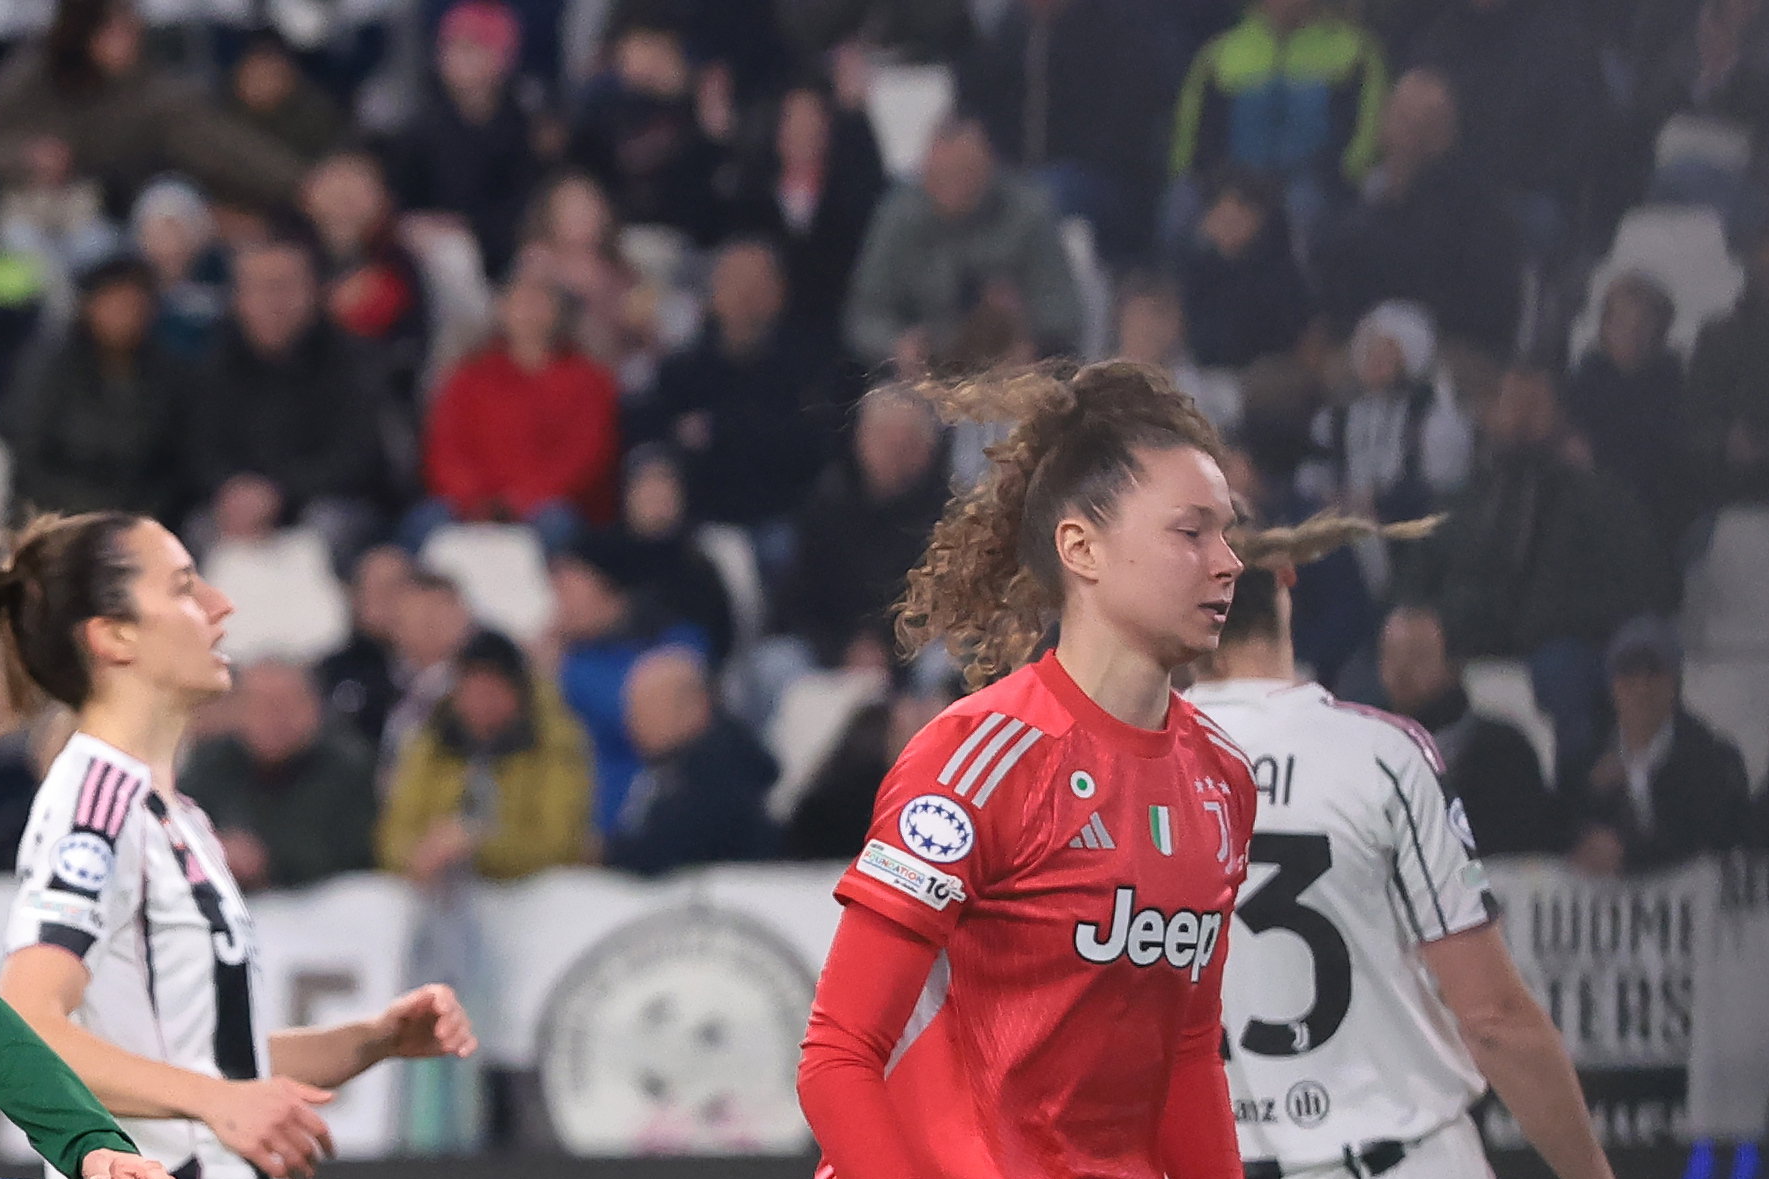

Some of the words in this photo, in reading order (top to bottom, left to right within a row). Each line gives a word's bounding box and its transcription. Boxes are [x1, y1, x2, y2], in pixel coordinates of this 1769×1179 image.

[1252, 753, 1295, 806] AI
[1074, 885, 1223, 984] Jeep
[1221, 832, 1352, 1059] 3
